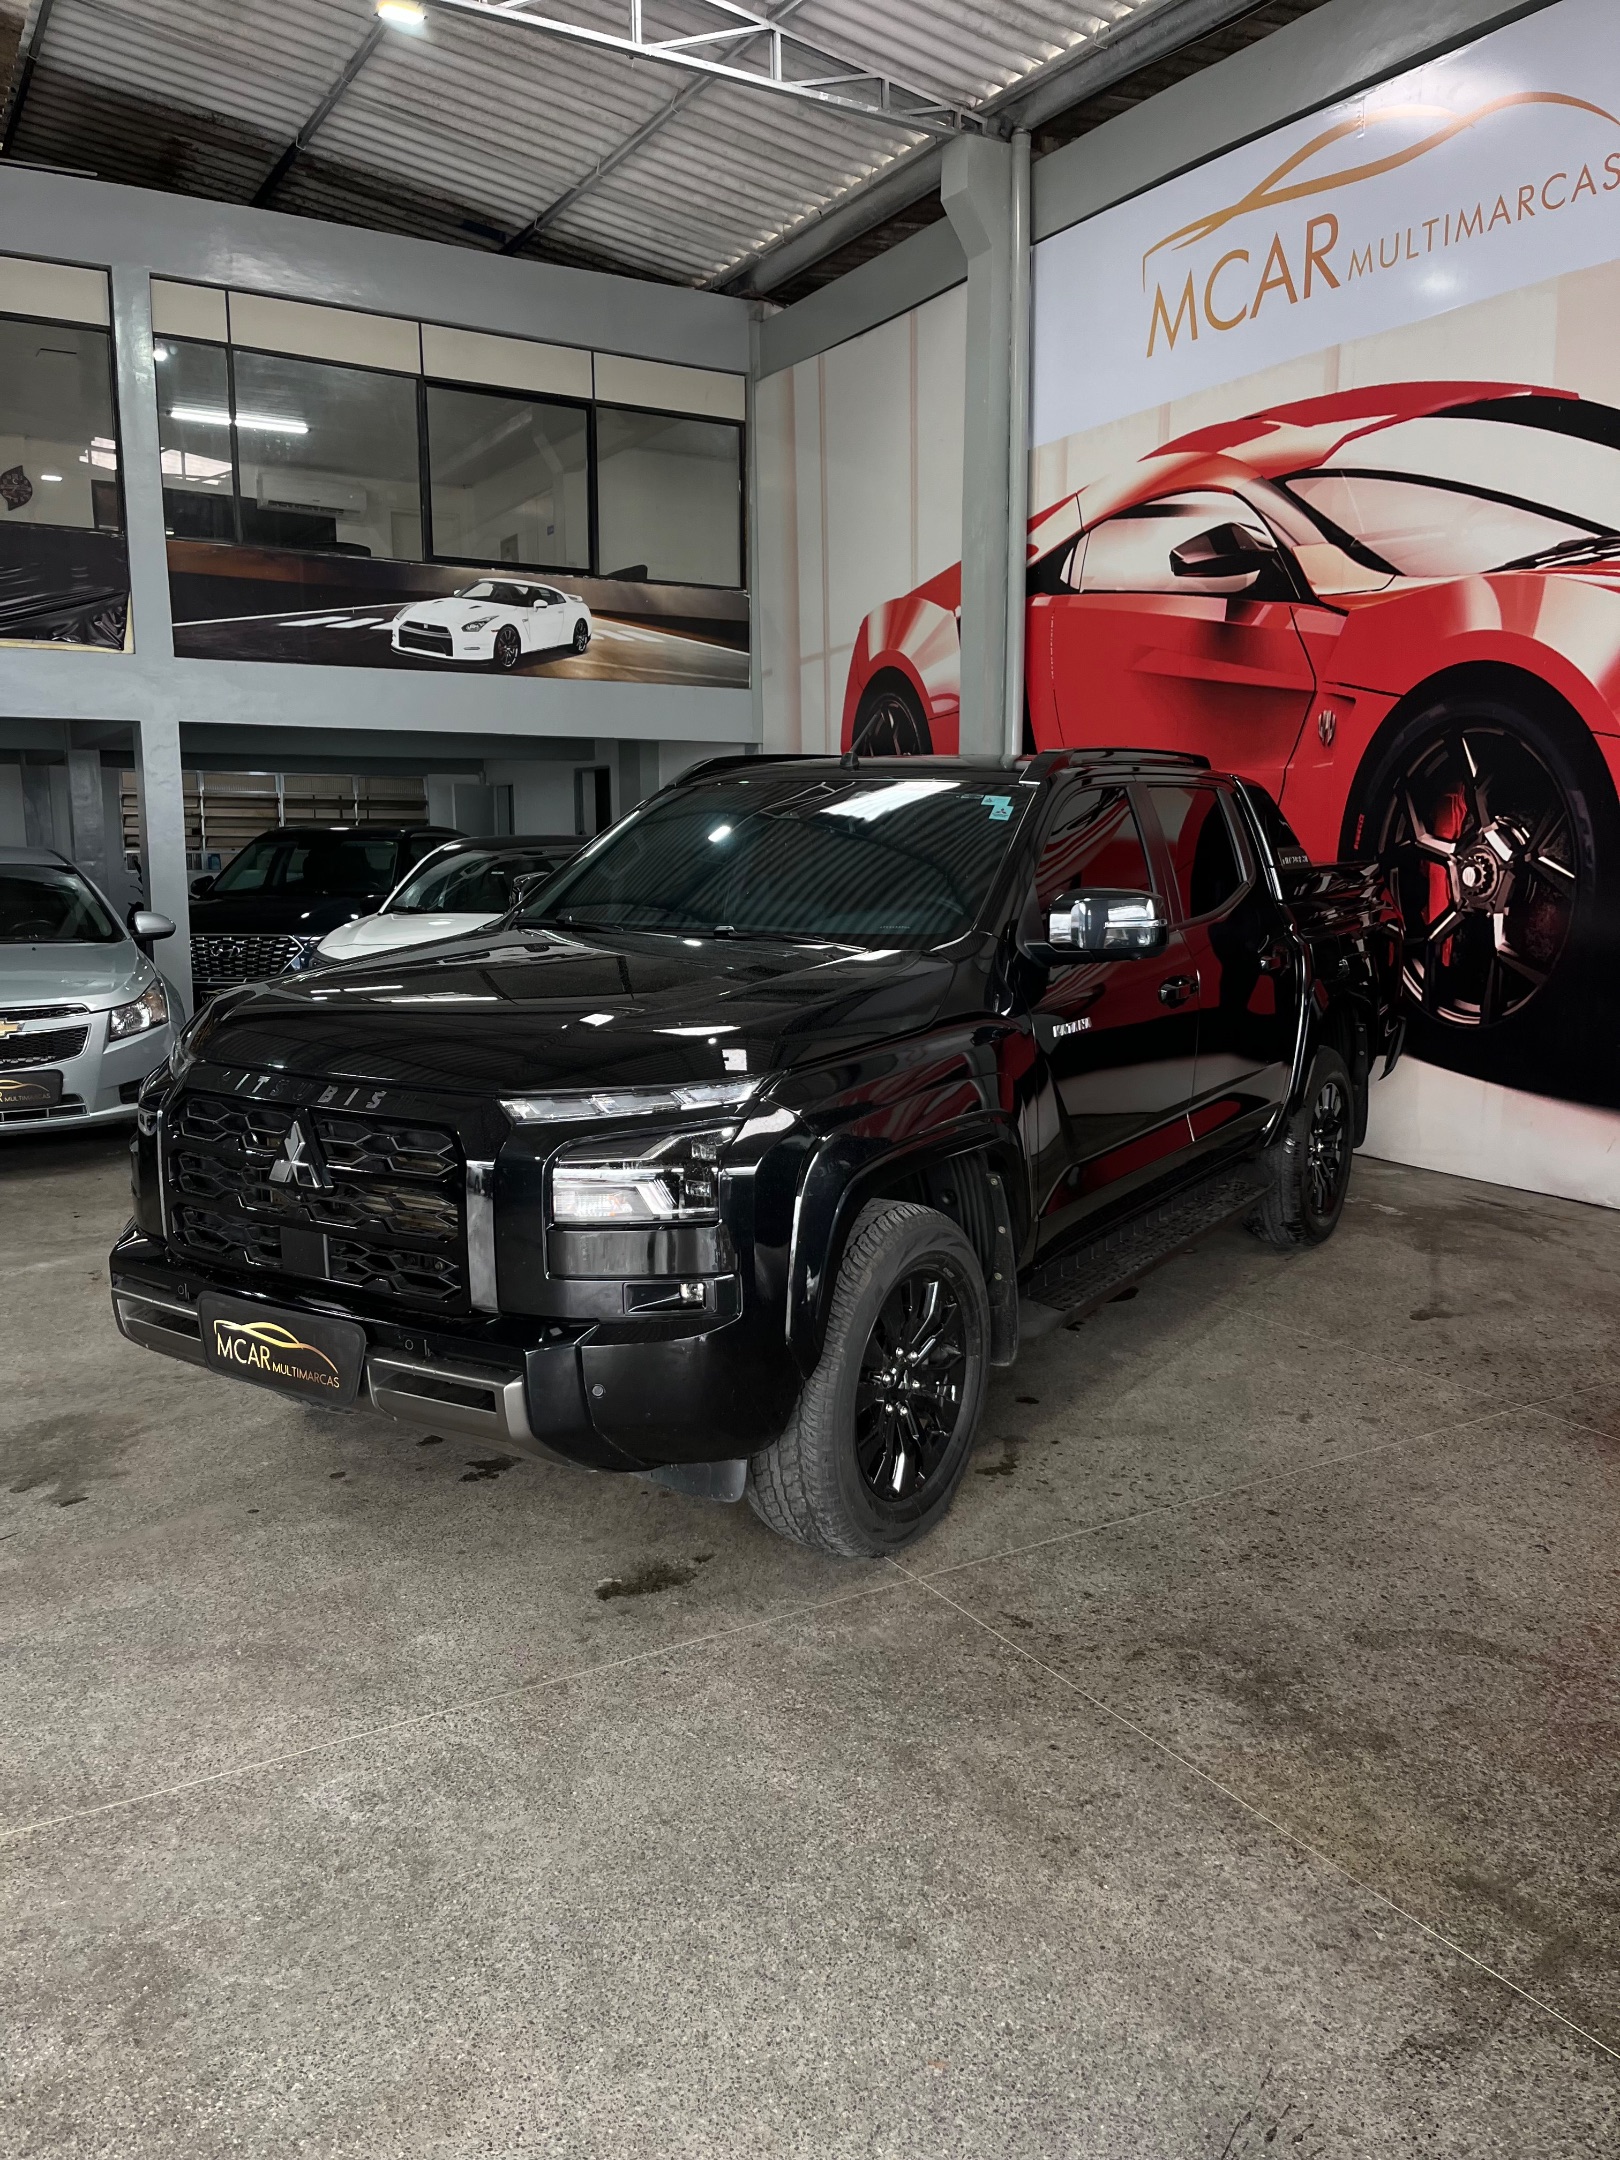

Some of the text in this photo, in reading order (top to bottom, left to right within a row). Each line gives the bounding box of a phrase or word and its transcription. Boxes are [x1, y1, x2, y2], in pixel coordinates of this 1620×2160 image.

[1147, 152, 1620, 358] MCAR MULTIMARCAS
[5, 1093, 50, 1102] MULTIMAAS
[217, 1332, 340, 1388] MCAR MULTIMARCAS
